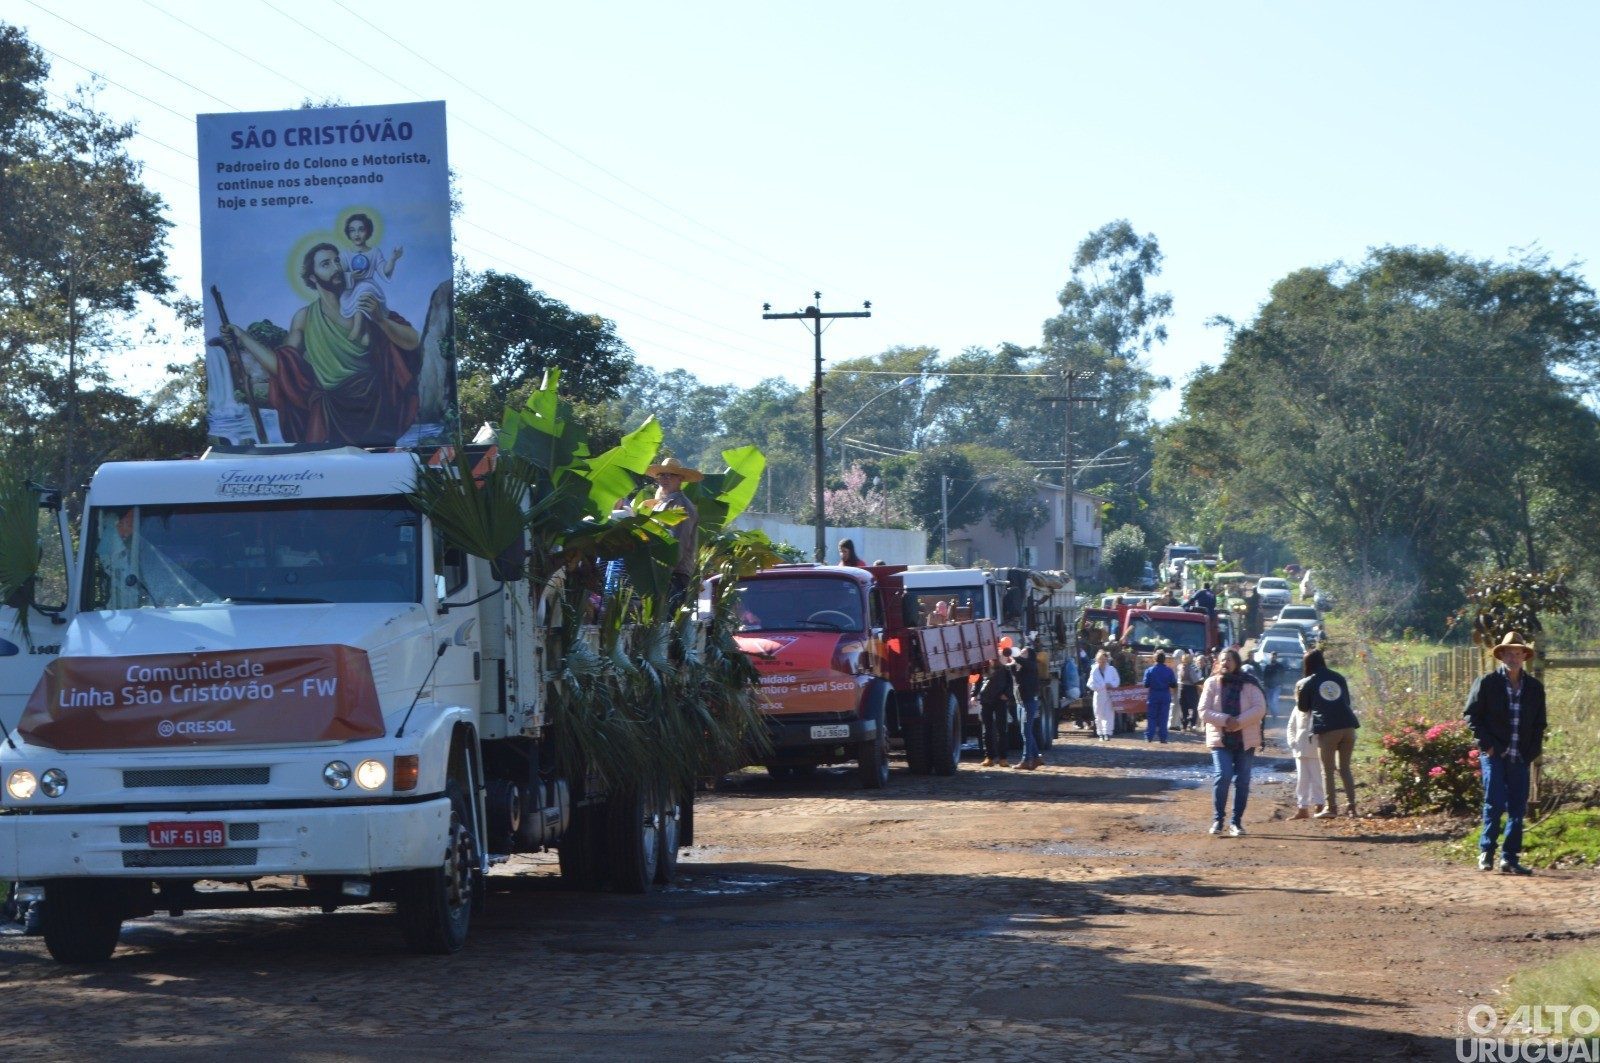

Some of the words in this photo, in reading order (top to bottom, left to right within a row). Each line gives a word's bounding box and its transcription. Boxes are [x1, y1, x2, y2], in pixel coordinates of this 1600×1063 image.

[231, 126, 277, 150] SÃO
[284, 117, 413, 147] CRISTÓVÃO
[217, 160, 280, 173] Padroeiro
[284, 159, 299, 170] do
[303, 157, 347, 170] Colono
[351, 158, 359, 167] e
[362, 152, 431, 167] Motorista,
[217, 178, 274, 191] continue
[278, 177, 300, 189] nos
[304, 172, 384, 187] abençoando
[217, 196, 246, 211] hoje
[250, 198, 258, 208] e
[261, 194, 313, 209] sempre.
[221, 469, 324, 485] Transportes
[126, 659, 264, 683] Comunidade
[59, 686, 115, 708] Linha
[122, 685, 163, 706] São
[170, 679, 274, 703] Cristóvão
[302, 678, 338, 697] FW
[800, 682, 828, 693] Erval
[829, 681, 855, 691] Seco
[176, 720, 236, 735] CRESOL
